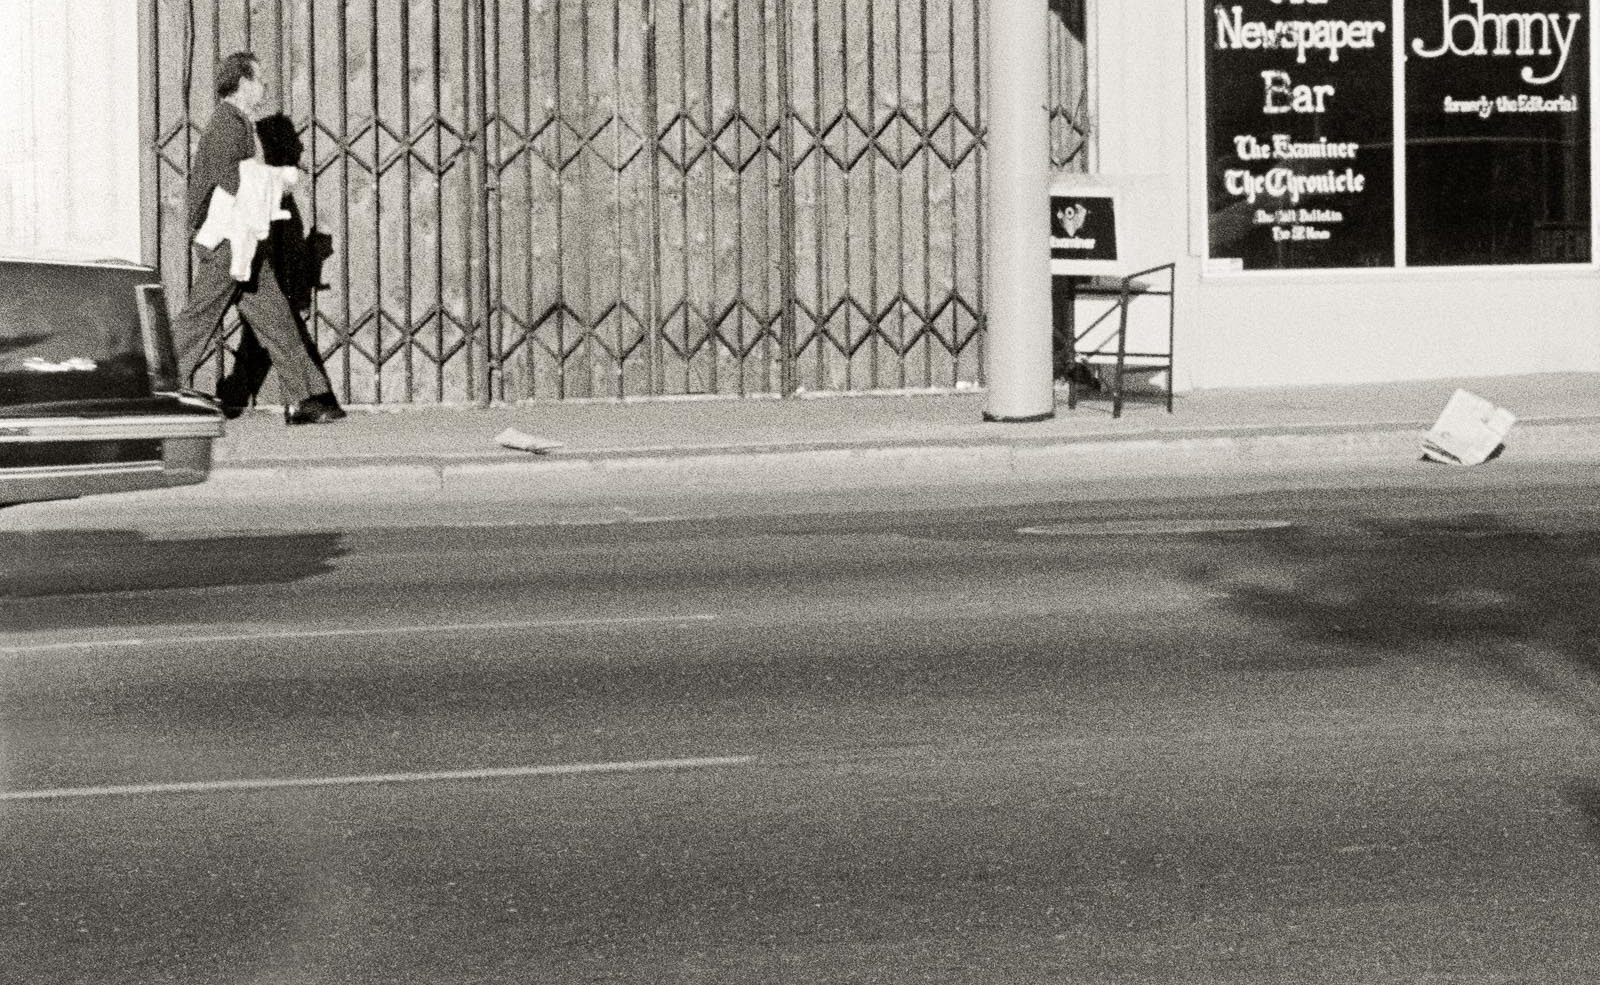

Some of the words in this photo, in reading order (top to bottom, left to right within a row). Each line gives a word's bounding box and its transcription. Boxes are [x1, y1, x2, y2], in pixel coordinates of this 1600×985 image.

[1213, 4, 1386, 64] Newspaper
[1495, 94, 1517, 113] the
[1517, 93, 1578, 113] Editorial
[1233, 134, 1271, 161] The
[1271, 133, 1359, 160] Examiner
[1223, 168, 1264, 204] The
[1264, 166, 1366, 203] Chronicle
